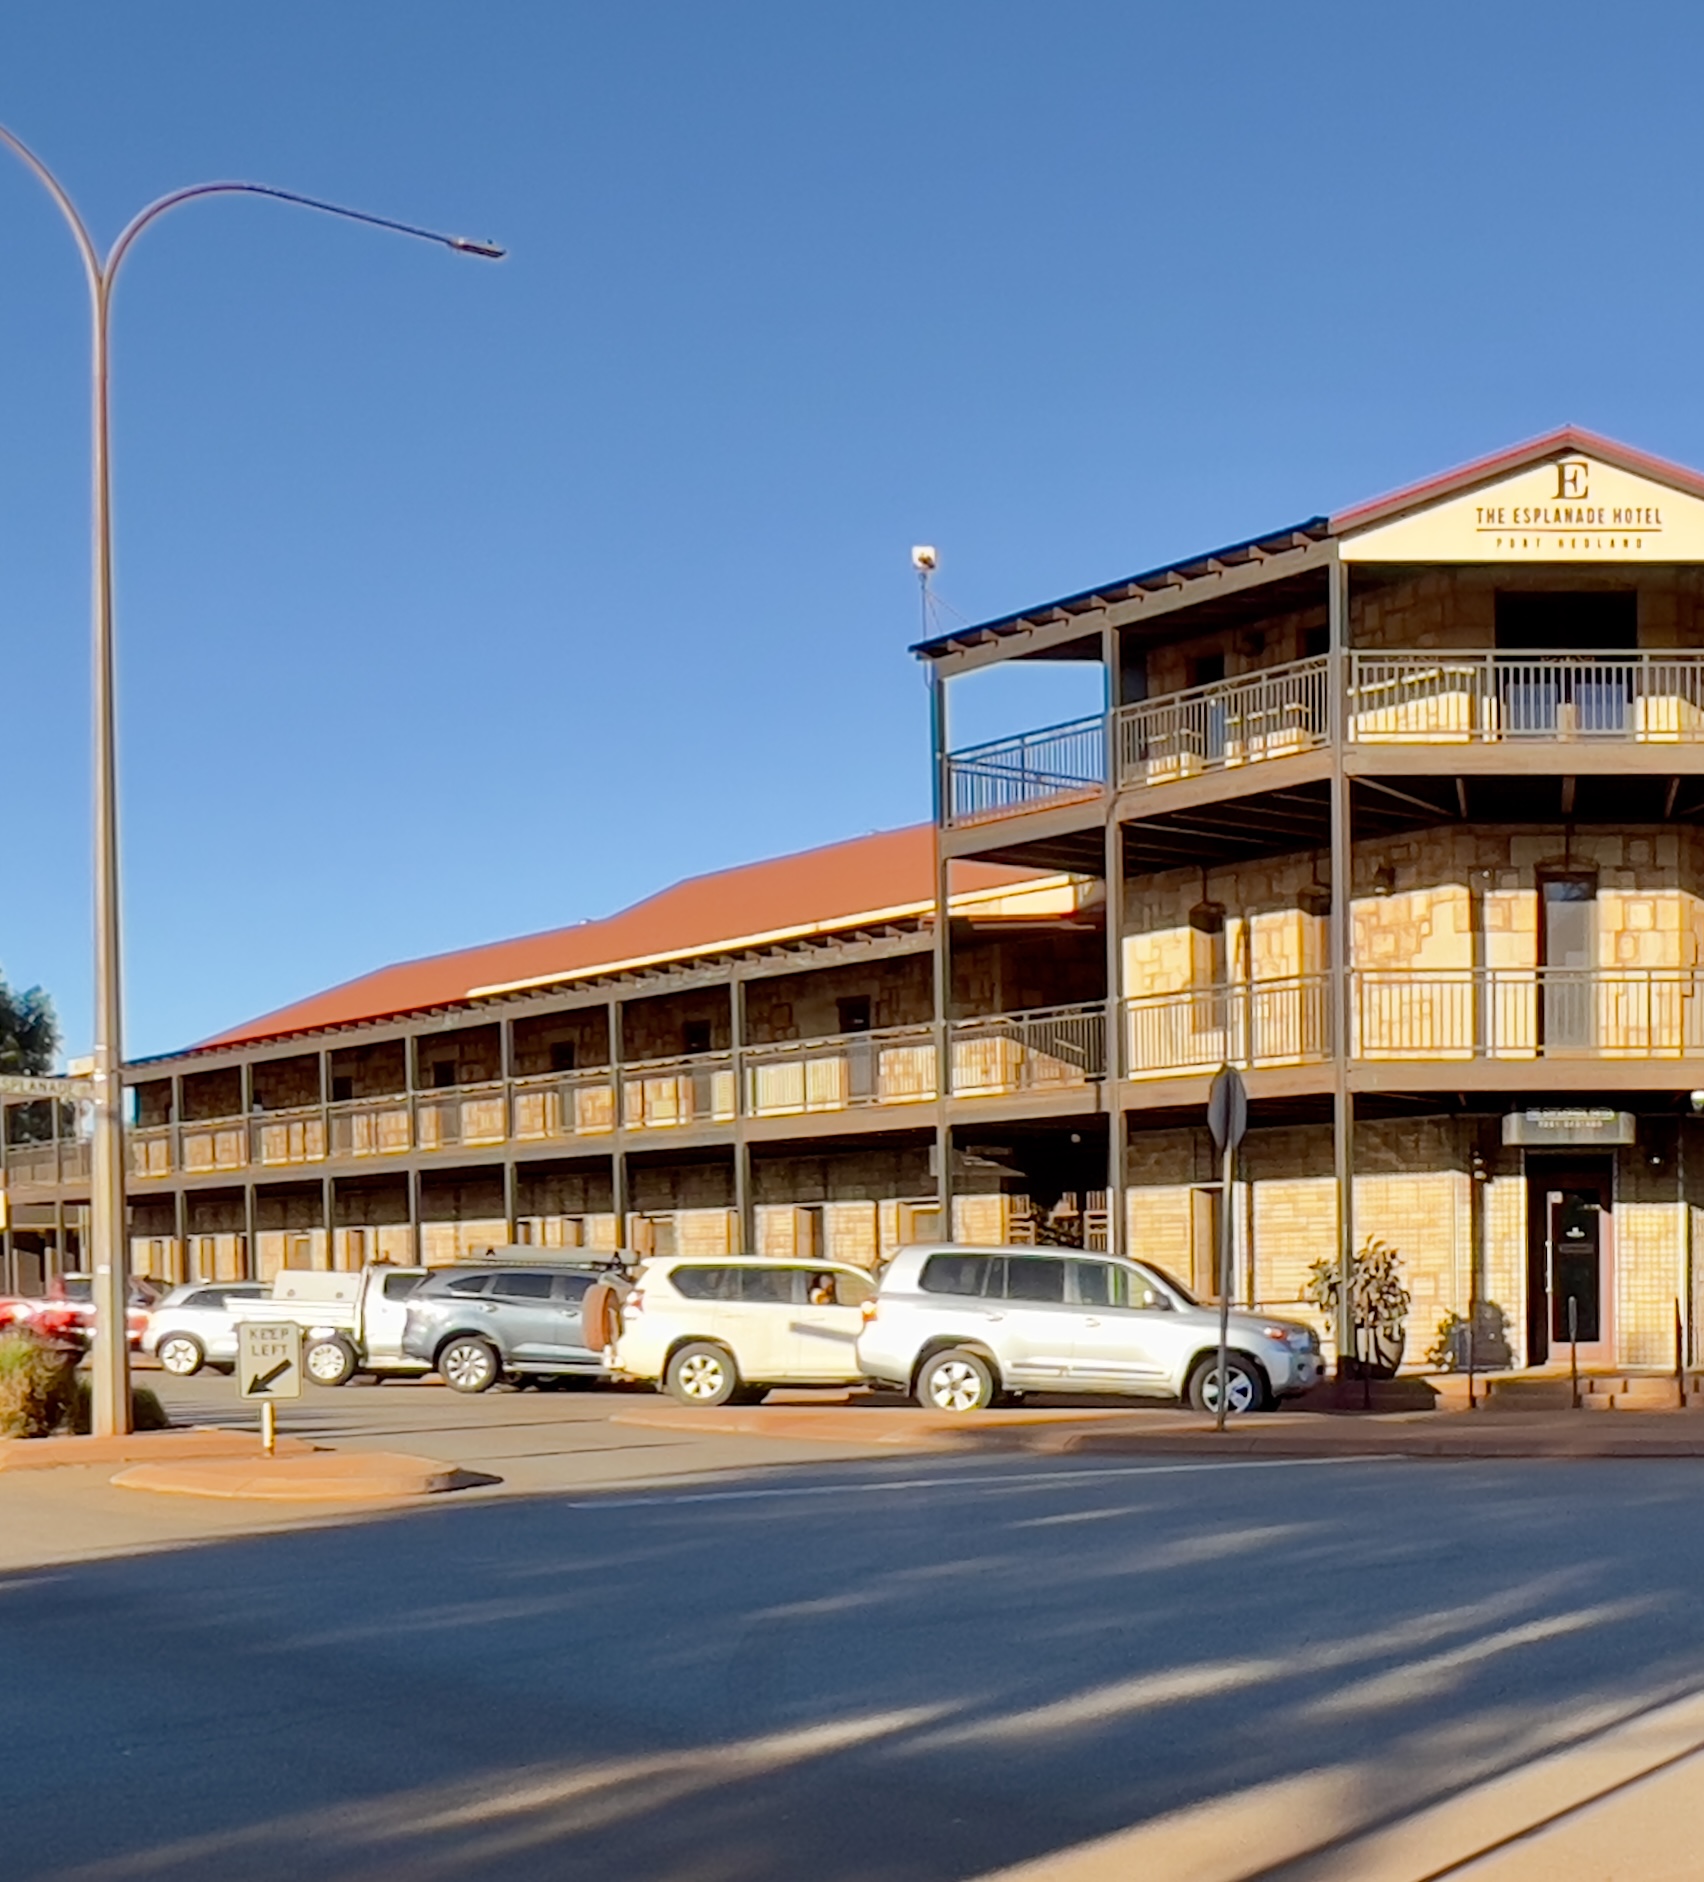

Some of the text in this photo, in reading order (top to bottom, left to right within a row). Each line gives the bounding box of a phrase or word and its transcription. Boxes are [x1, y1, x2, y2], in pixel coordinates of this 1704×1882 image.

[1551, 462, 1589, 500] E
[1476, 507, 1662, 525] THE ESPLANADE HOTEL
[1496, 538, 1541, 549] PORT
[249, 1328, 289, 1341] KEEP
[251, 1344, 288, 1357] LEFT
